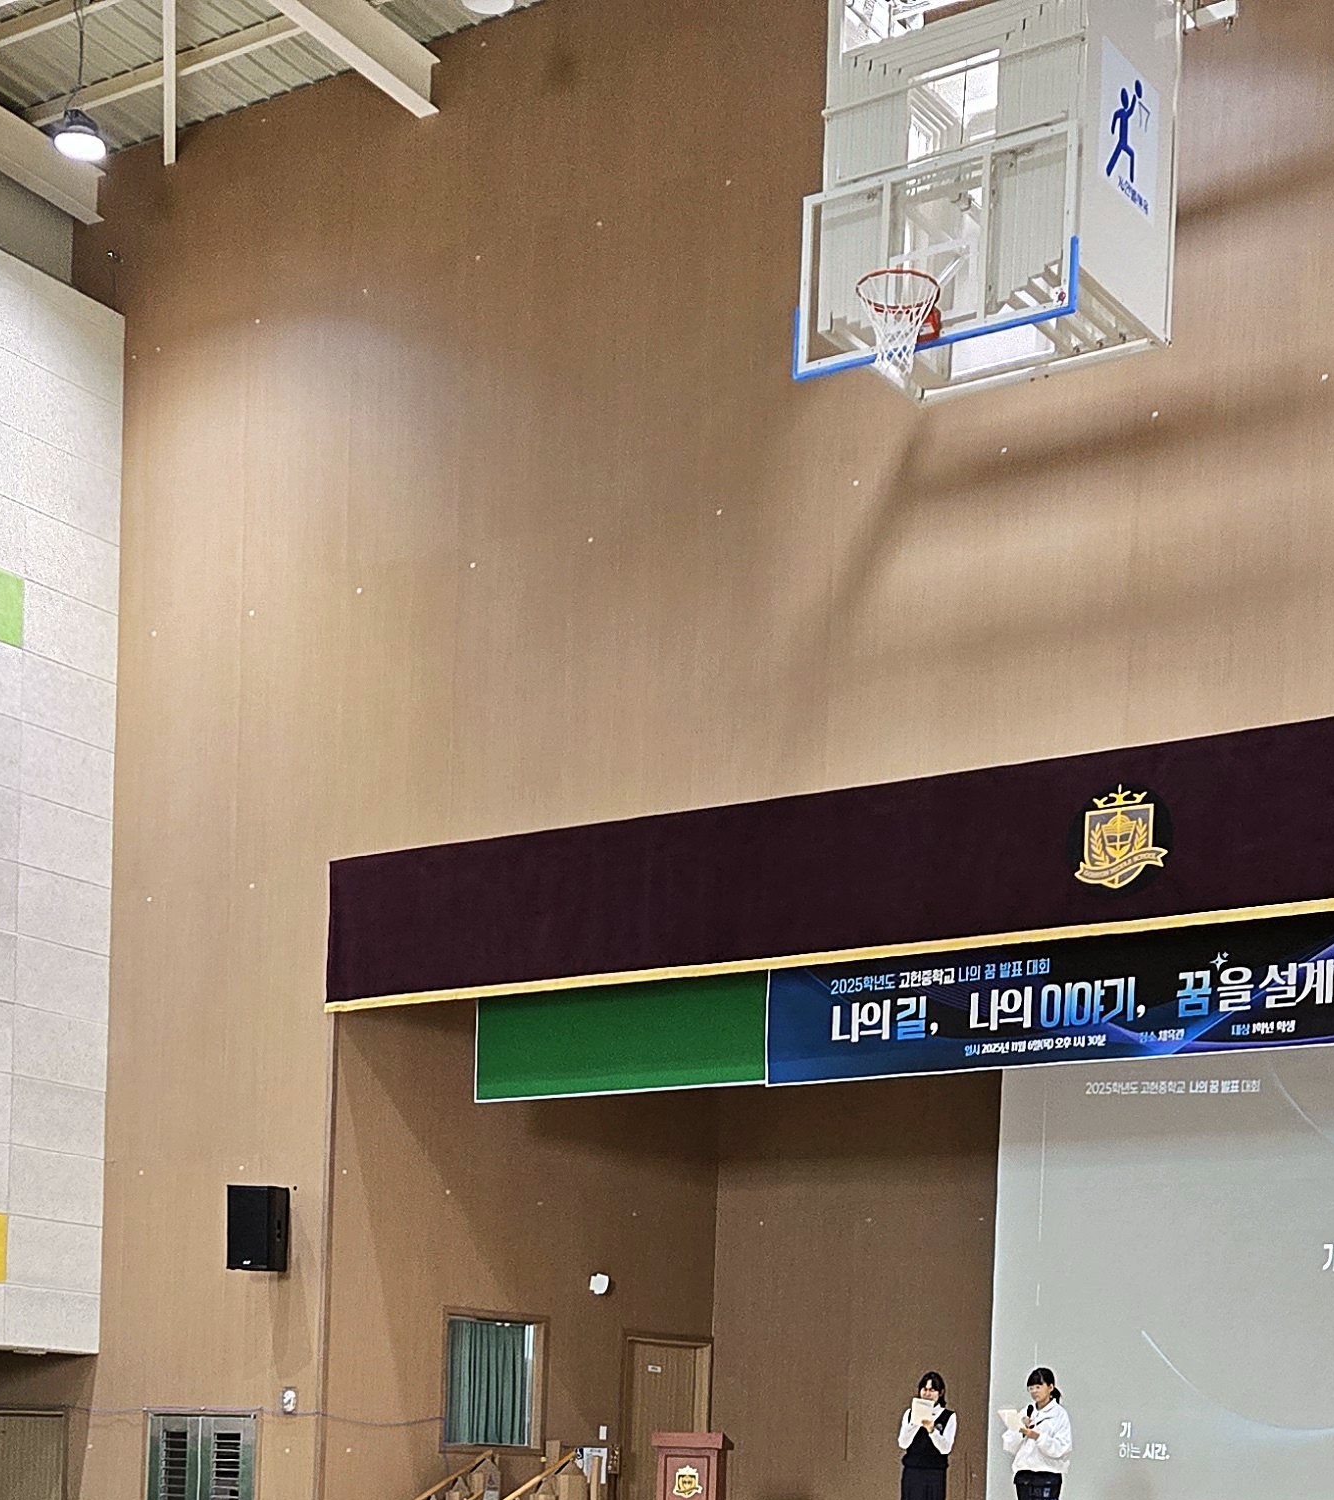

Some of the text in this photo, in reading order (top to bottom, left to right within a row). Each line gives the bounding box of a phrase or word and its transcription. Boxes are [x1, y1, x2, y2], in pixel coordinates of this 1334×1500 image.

[830, 957, 1050, 996] 2025학년도 고헌중학교 나의 꿈 발표 대회
[831, 999, 890, 1042] 나의
[896, 995, 938, 1041] 길,
[969, 985, 1032, 1031] 나의
[1040, 976, 1146, 1029] 이야기,
[1176, 966, 1254, 1018] 꿈을
[1139, 1028, 1185, 1043] 장소 체육관
[1231, 1019, 1296, 1036] 대상 1학년 학생
[964, 1044, 980, 1056] 일시
[981, 1041, 1009, 1054] 2025년
[1054, 1036, 1072, 1049] 오후
[1087, 1034, 1106, 1047] 30분
[1085, 1078, 1261, 1095] 2025학년도 고헌중학교 나의 꿈 발표 대회
[1119, 1442, 1170, 1460] 하는 시간.
